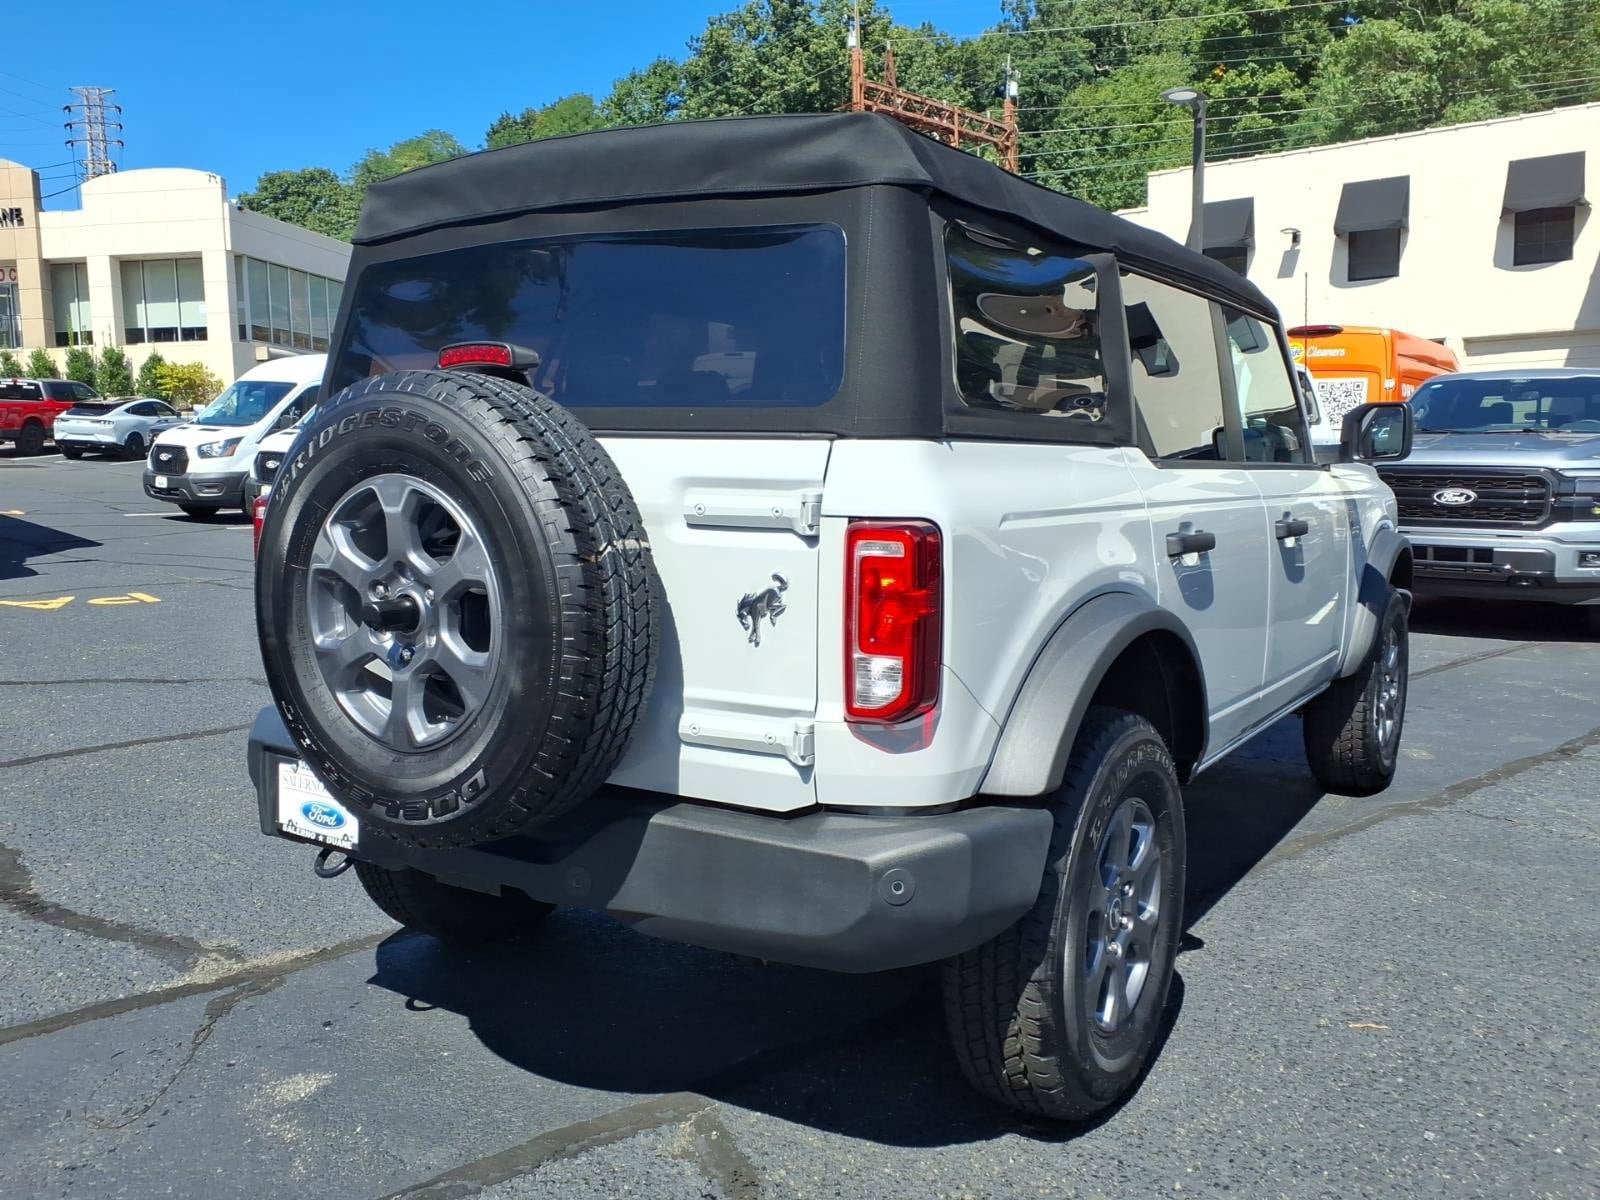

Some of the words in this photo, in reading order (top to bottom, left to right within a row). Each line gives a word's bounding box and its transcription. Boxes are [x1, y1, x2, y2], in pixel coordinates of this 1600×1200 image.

[274, 404, 496, 506] BRIDGESTONE
[308, 804, 338, 826] Ford
[282, 823, 316, 840] SALERNO
[326, 835, 353, 850] DUANE
